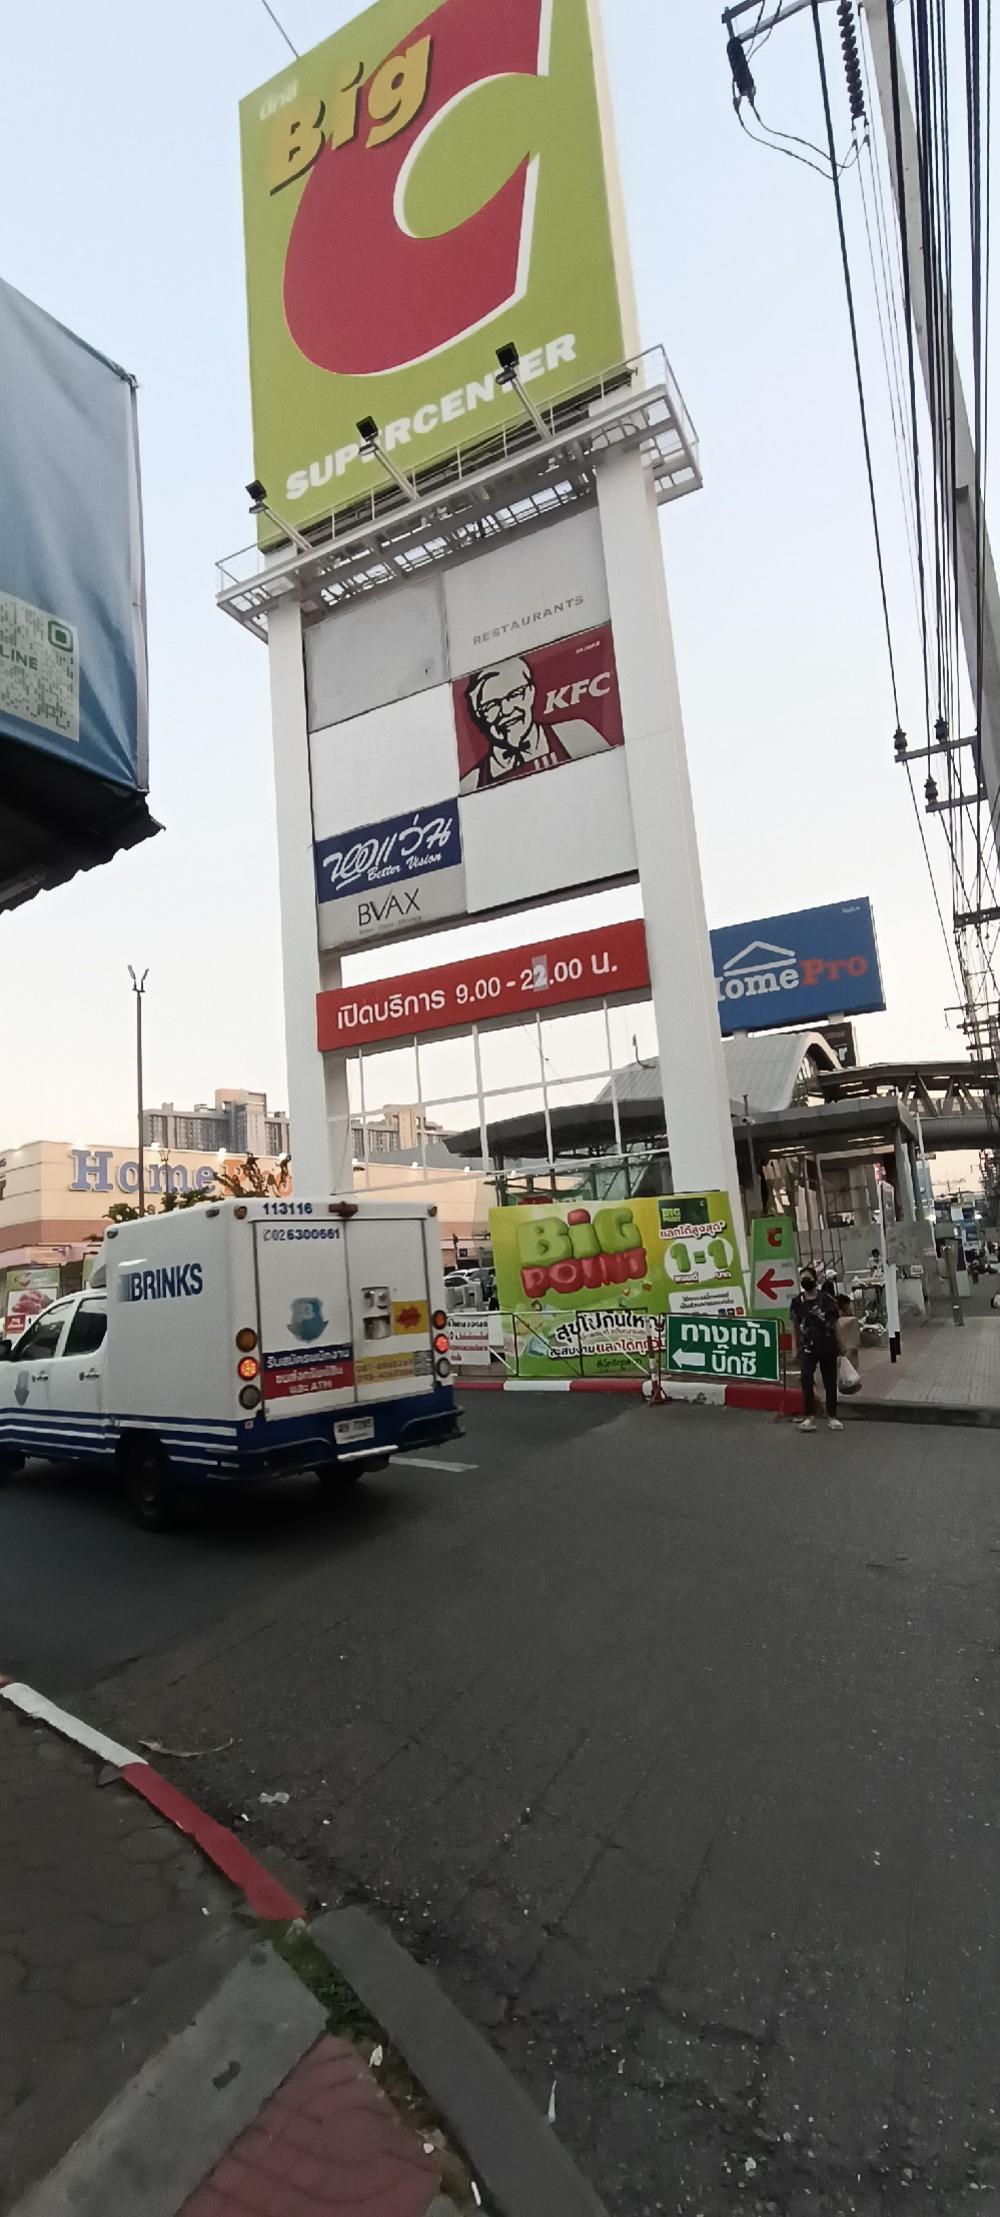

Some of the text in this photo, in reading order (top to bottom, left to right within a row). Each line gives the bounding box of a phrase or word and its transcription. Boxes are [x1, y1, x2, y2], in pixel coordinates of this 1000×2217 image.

[266, 34, 434, 196] Big
[283, 0, 553, 377] C
[472, 595, 585, 647] RESTAURANTS
[0, 644, 38, 671] LINE
[543, 671, 612, 715] KFC
[367, 852, 442, 882] Better Vision
[357, 887, 421, 927] BVAX
[337, 988, 446, 1029] เปิดบริการ
[455, 977, 501, 1004] 9.00
[520, 958, 583, 991] 22.00
[590, 952, 618, 975] น.
[263, 1202, 313, 1215] 113116
[131, 1262, 203, 1302] BRINKS
[520, 1247, 648, 1299] POINT
[681, 1321, 771, 1348] ทางเข้า
[711, 1344, 757, 1376] บิ๊กซี
[310, 1380, 333, 1392] ATM
